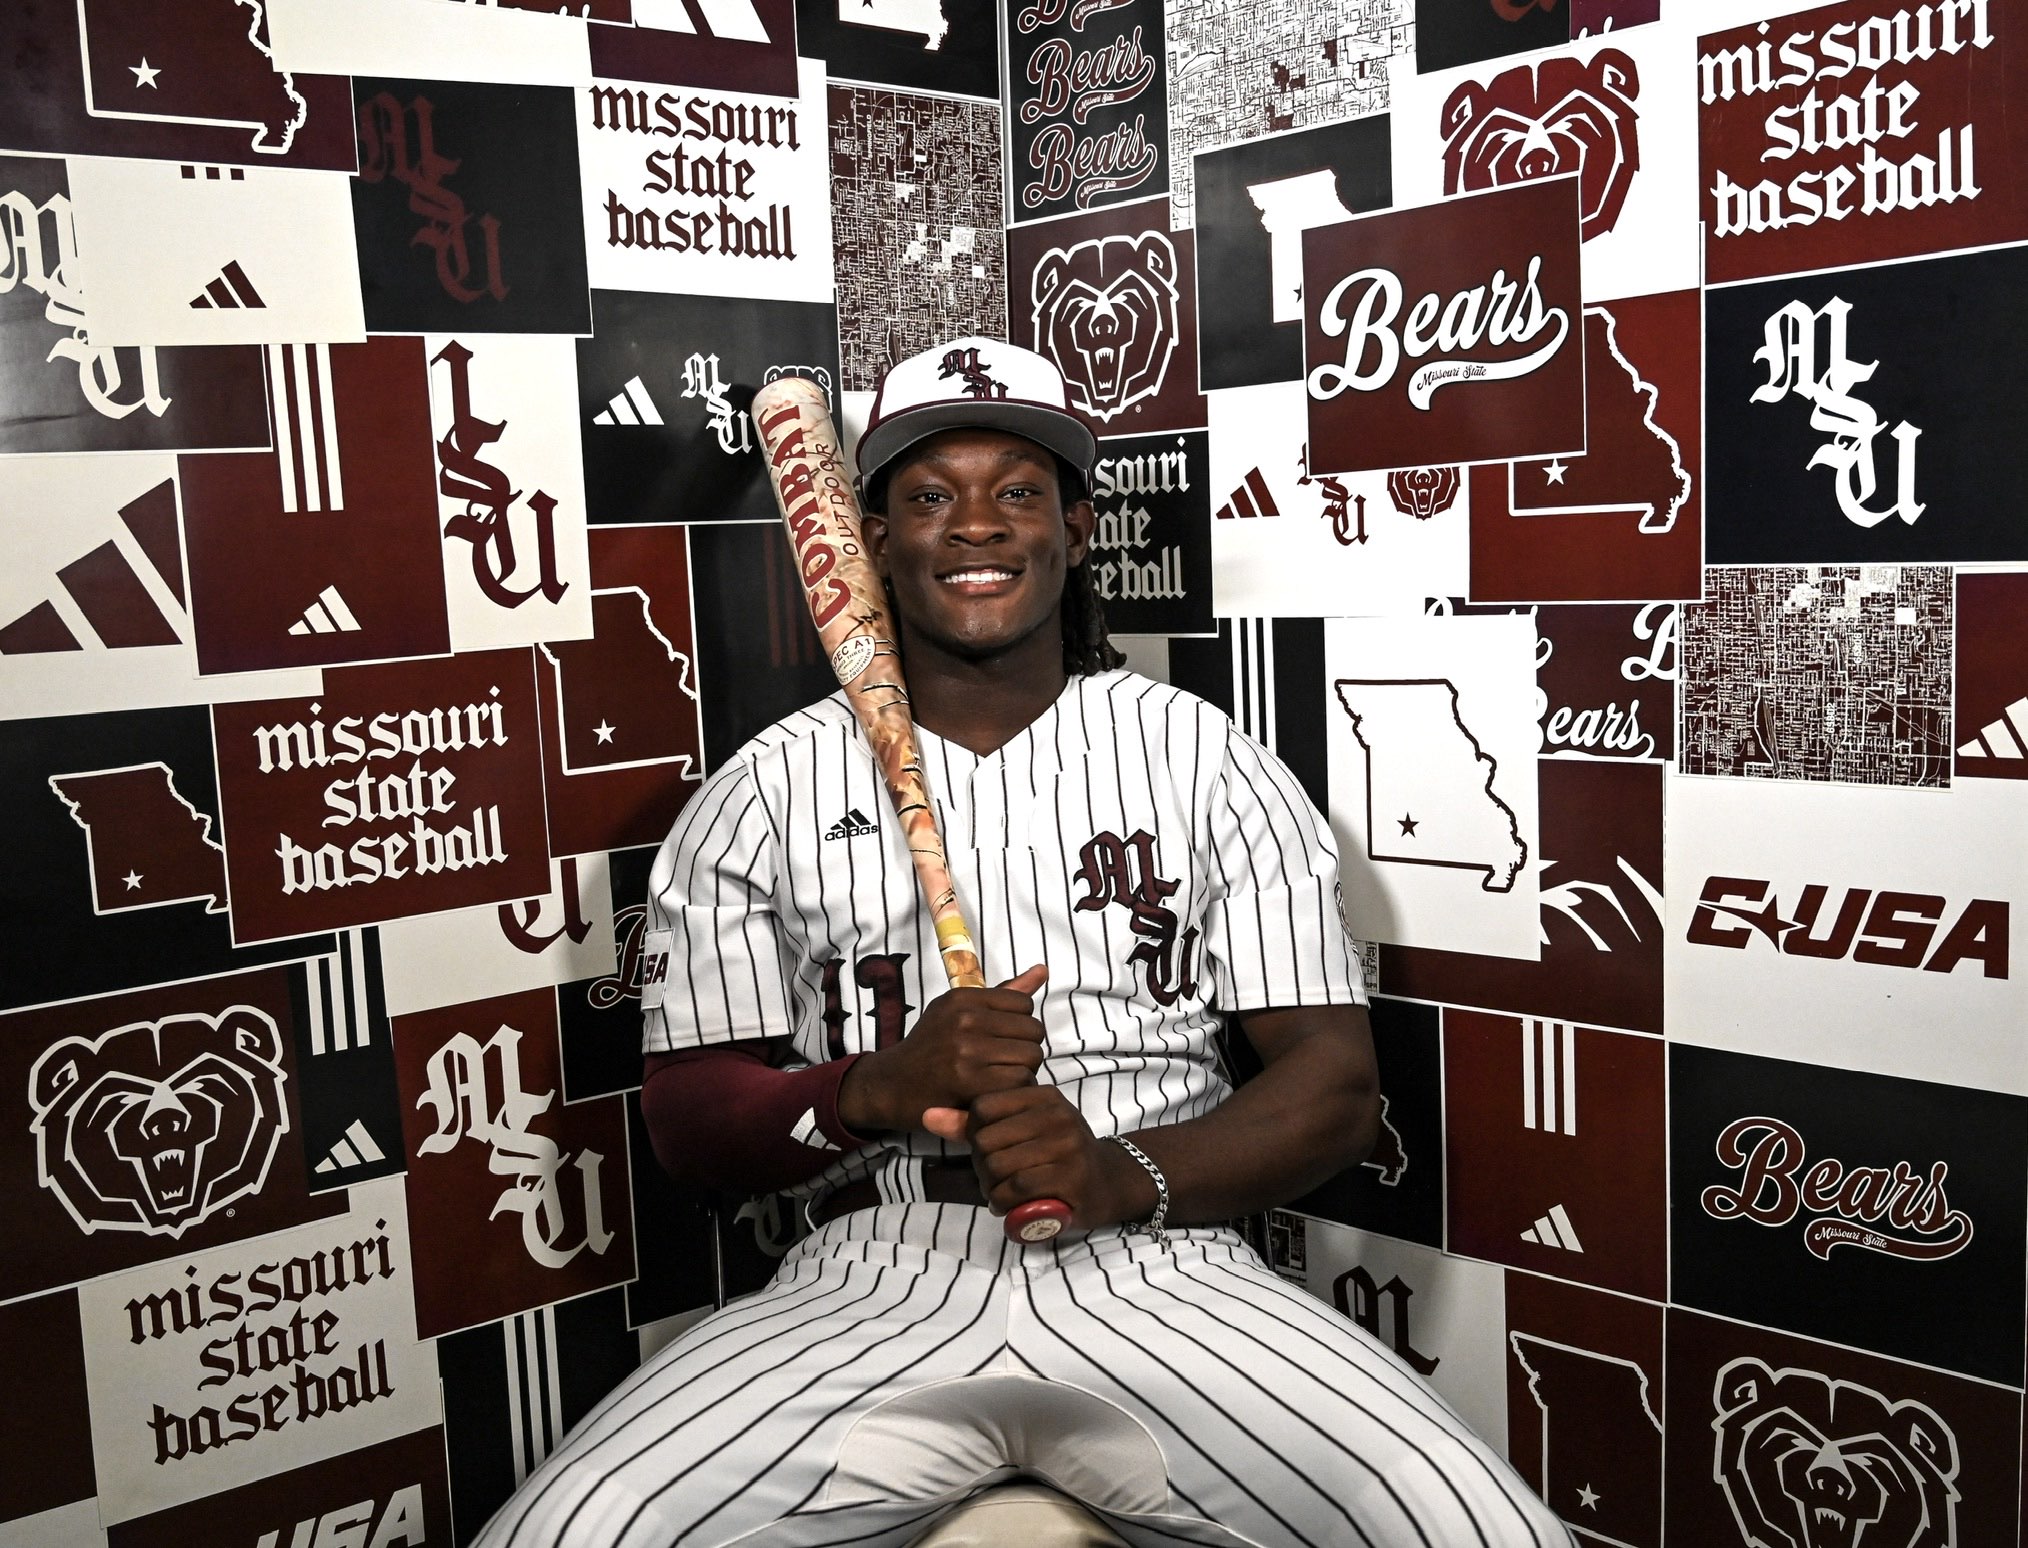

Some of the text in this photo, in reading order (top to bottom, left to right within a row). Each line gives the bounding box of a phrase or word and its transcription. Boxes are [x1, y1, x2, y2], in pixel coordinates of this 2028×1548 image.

[1020, 25, 1152, 124] Bears
[1697, 0, 1995, 106] missouri
[588, 85, 801, 152] missouri
[1023, 113, 1155, 208] Bears
[1760, 73, 1921, 163] state
[642, 141, 756, 202] state
[1709, 122, 1983, 239] baseball
[602, 187, 798, 262] baseball
[1307, 255, 1569, 401] Bears
[1416, 364, 1488, 392] Missouri State
[757, 404, 852, 632] COMBAT
[814, 442, 859, 557] OUTDOOR
[253, 685, 509, 774] missouri
[321, 757, 457, 828] state
[824, 824, 879, 842] adidas
[275, 804, 509, 896] baseball
[1701, 1116, 1965, 1234] Bears
[124, 1218, 396, 1345] missouri
[1814, 1226, 1888, 1249] Missouri State
[197, 1306, 340, 1391] state
[147, 1338, 396, 1466] baseball
